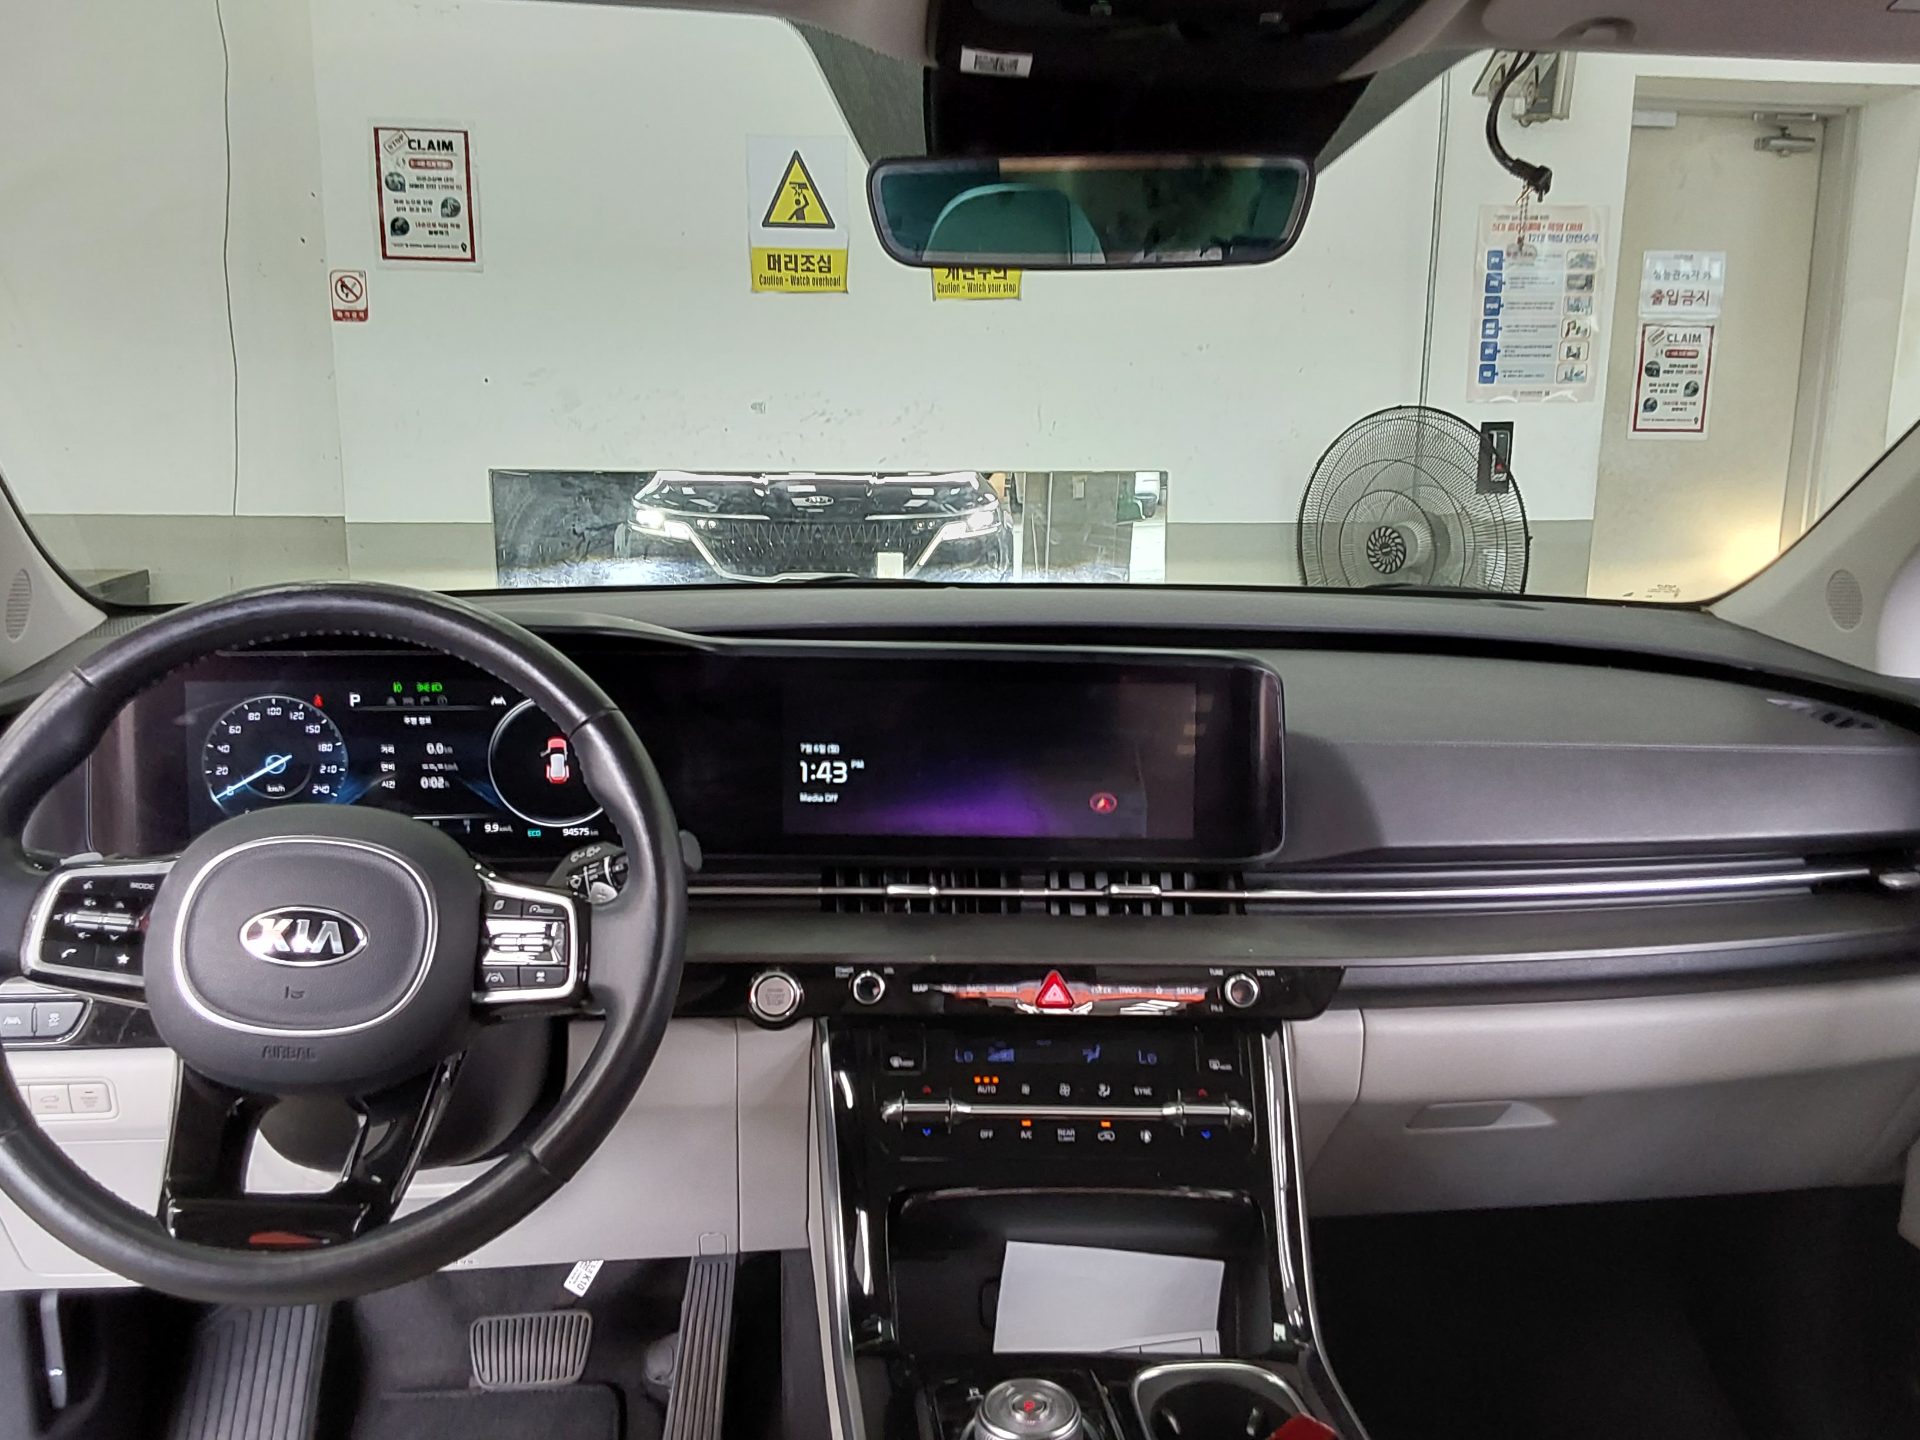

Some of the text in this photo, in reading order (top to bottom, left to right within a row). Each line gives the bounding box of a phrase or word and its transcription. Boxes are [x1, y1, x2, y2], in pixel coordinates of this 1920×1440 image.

[408, 139, 454, 152] CLAIM
[767, 254, 832, 273] 머리조심
[759, 274, 784, 286] Caution
[790, 275, 811, 287] Watch
[937, 282, 960, 293] Caution
[967, 282, 986, 293] Watch
[1651, 289, 1710, 307] 출입금지
[1667, 333, 1702, 343] CLAIM
[349, 693, 361, 707] P
[266, 707, 282, 716] 100
[289, 711, 305, 720] 120
[247, 712, 261, 721] 80
[228, 726, 242, 734] 60
[305, 725, 321, 734] 150
[217, 744, 230, 753] 40
[318, 743, 333, 752] 180
[426, 742, 444, 755] 0.0
[215, 766, 229, 775] 20
[319, 765, 337, 774] 210
[799, 760, 848, 784] 1:43
[312, 785, 330, 794] 240
[484, 822, 499, 833] 9.9
[562, 827, 590, 837] 94575
[528, 829, 541, 837] ECO
[130, 882, 155, 890] MODE
[257, 917, 346, 955] KIA
[912, 984, 928, 993] MAP
[1176, 986, 1199, 994] SETUP
[977, 1085, 996, 1094] AUTO
[980, 1129, 993, 1139] OFF
